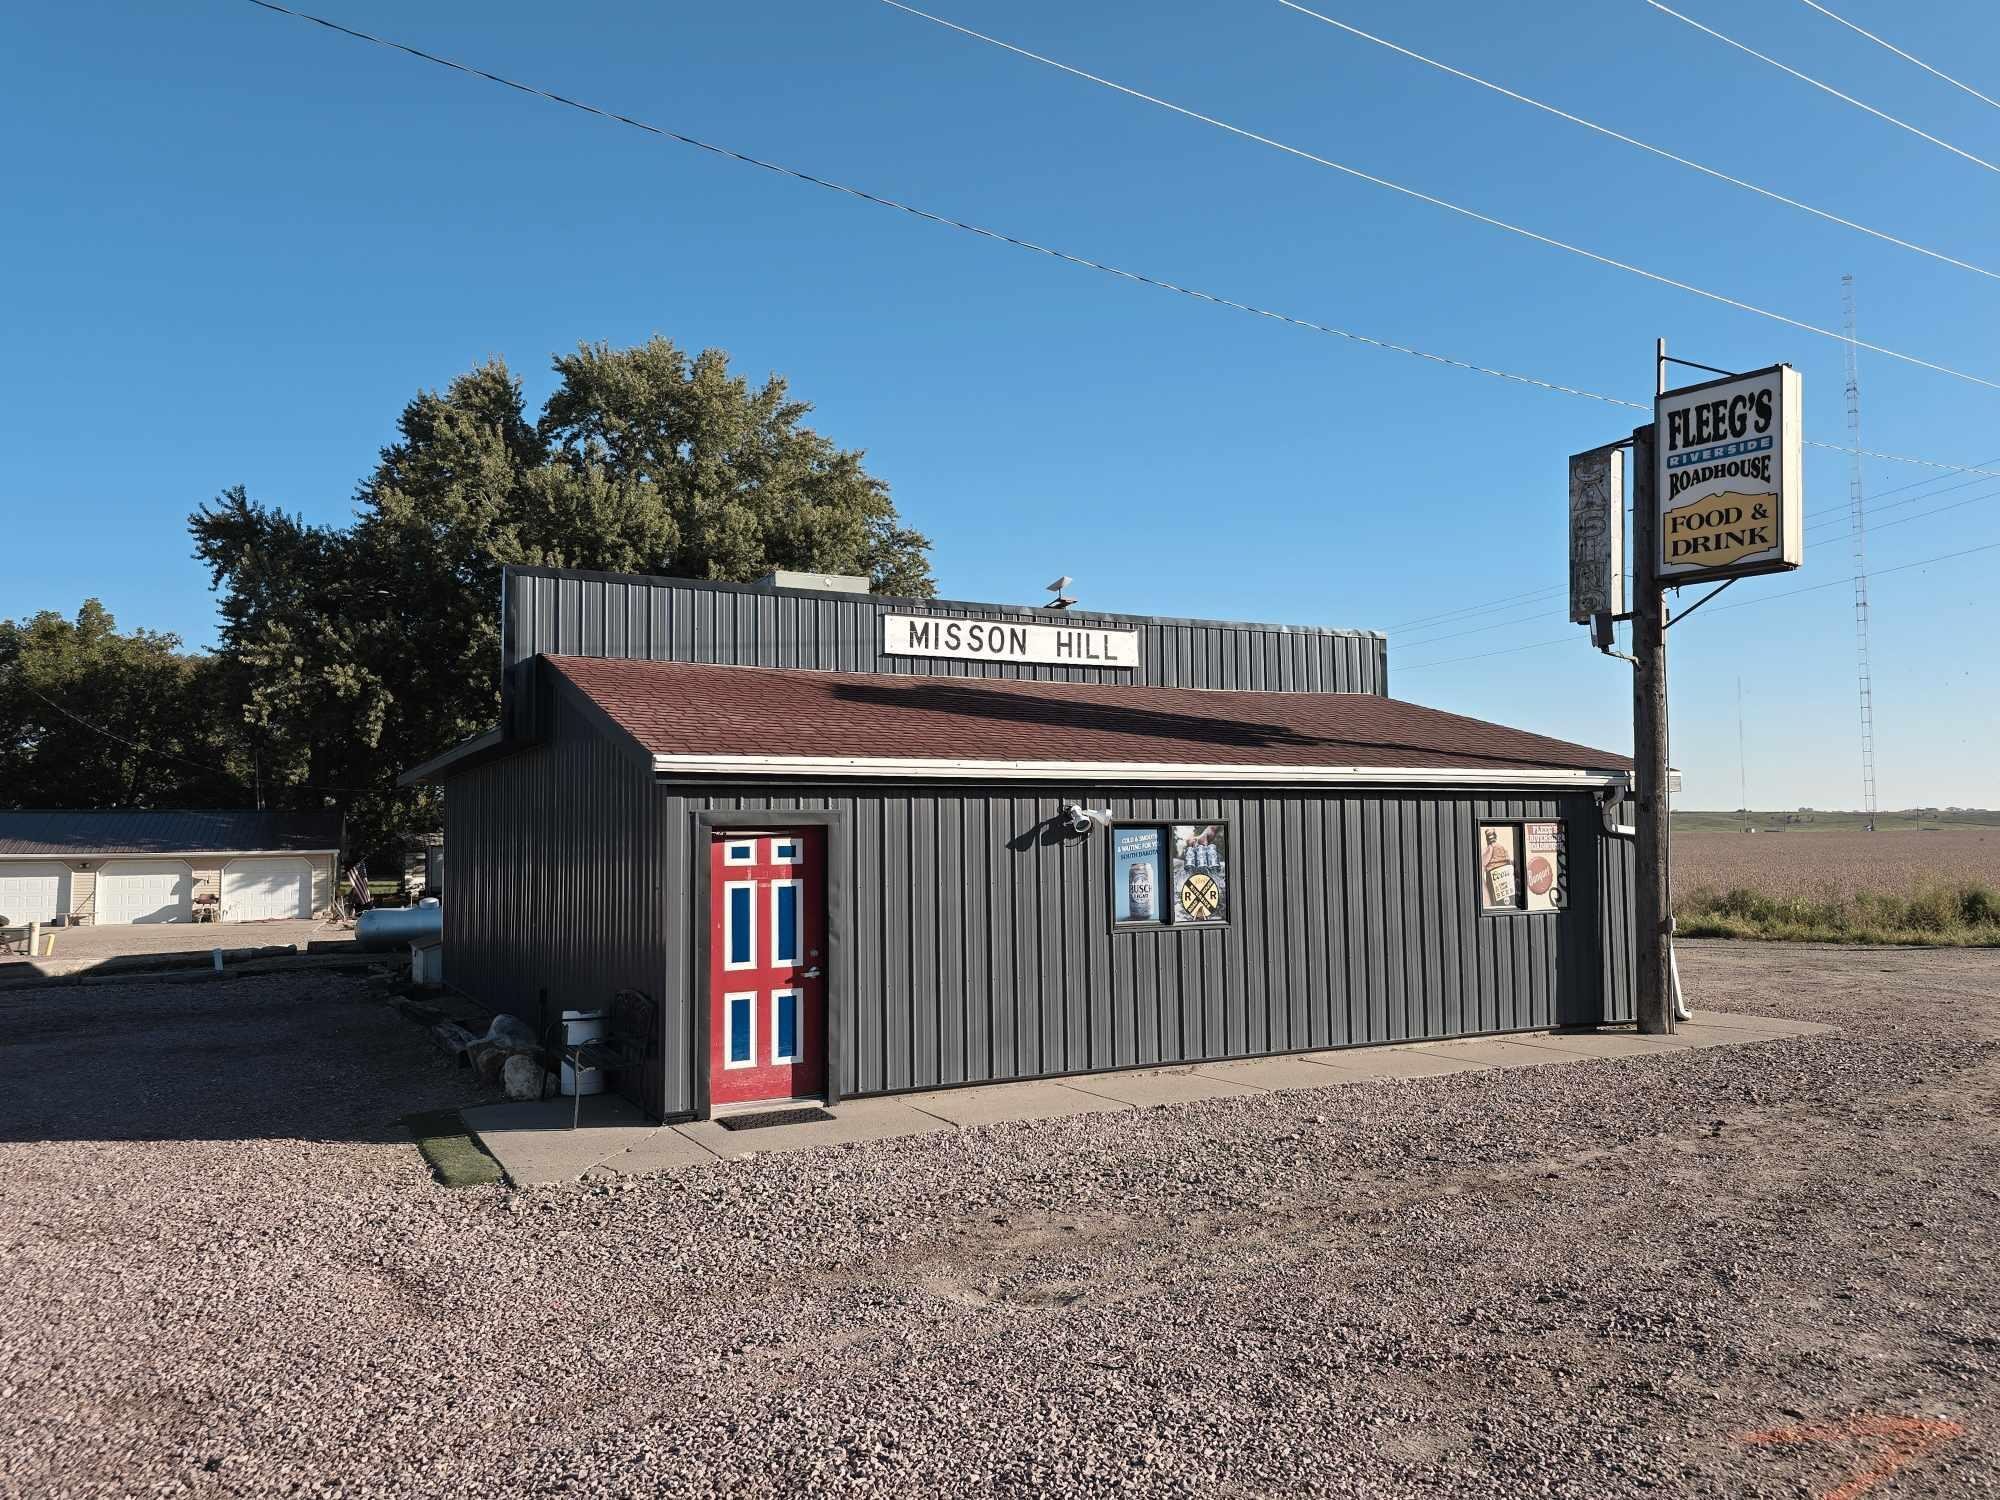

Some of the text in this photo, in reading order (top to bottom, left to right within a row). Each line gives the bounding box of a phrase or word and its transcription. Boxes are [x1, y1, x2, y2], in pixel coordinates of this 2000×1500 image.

[1667, 388, 1773, 451] FLEEG'S
[1669, 438, 1770, 467] RIVERSIDE
[1669, 455, 1771, 501] ROADHOUSE
[1671, 503, 1769, 533] FOOD &
[1672, 526, 1769, 557] DRINK
[909, 620, 1118, 661] MISSON HILL
[1184, 890, 1217, 901] R R
